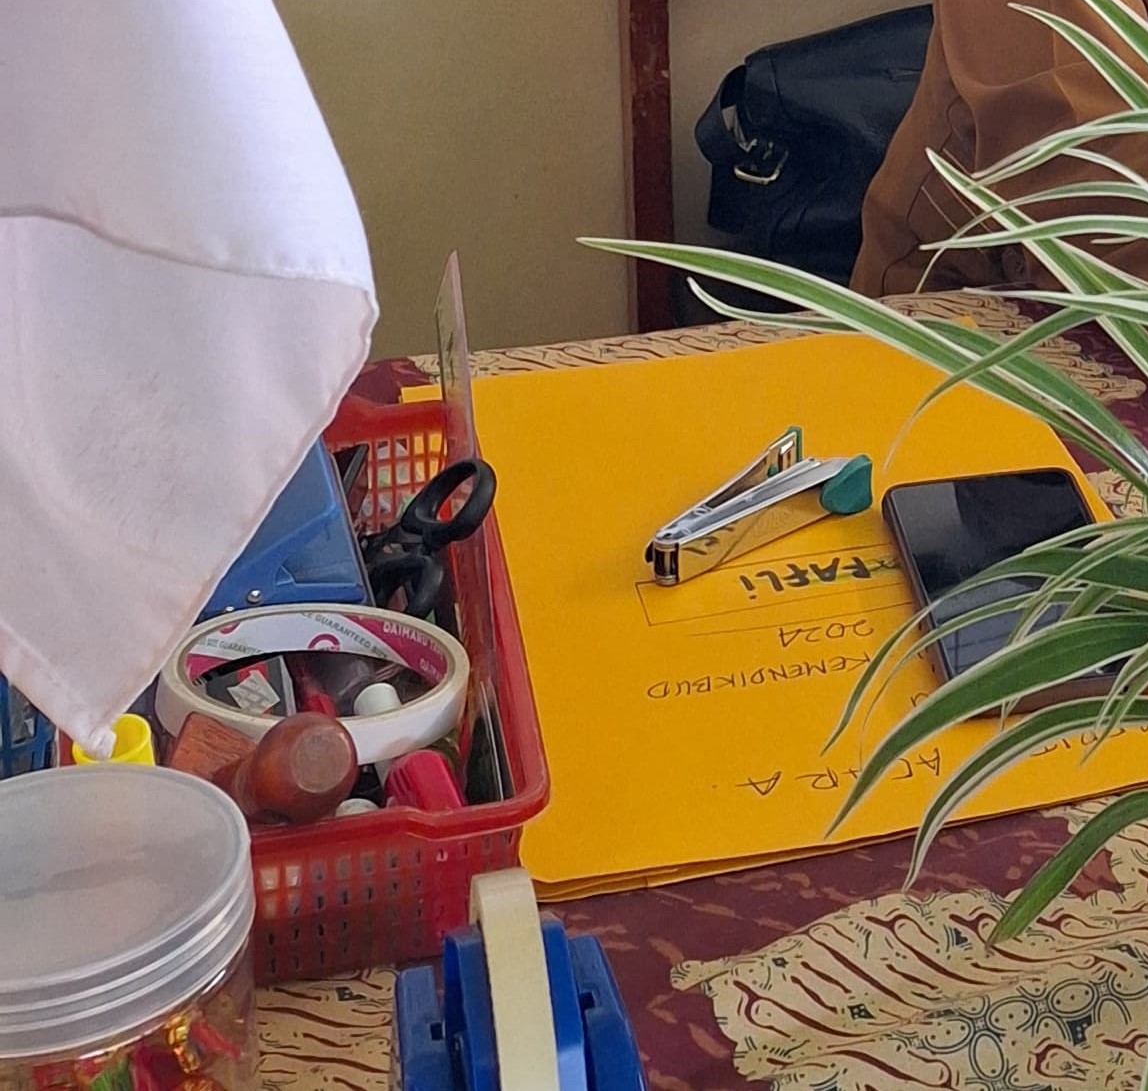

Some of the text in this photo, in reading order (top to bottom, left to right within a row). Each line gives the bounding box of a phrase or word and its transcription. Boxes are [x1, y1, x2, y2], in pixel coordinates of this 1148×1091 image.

[315, 613, 371, 649] GUARANTEED
[779, 619, 875, 648] 2024
[647, 650, 872, 699] KEMENDIKBUD
